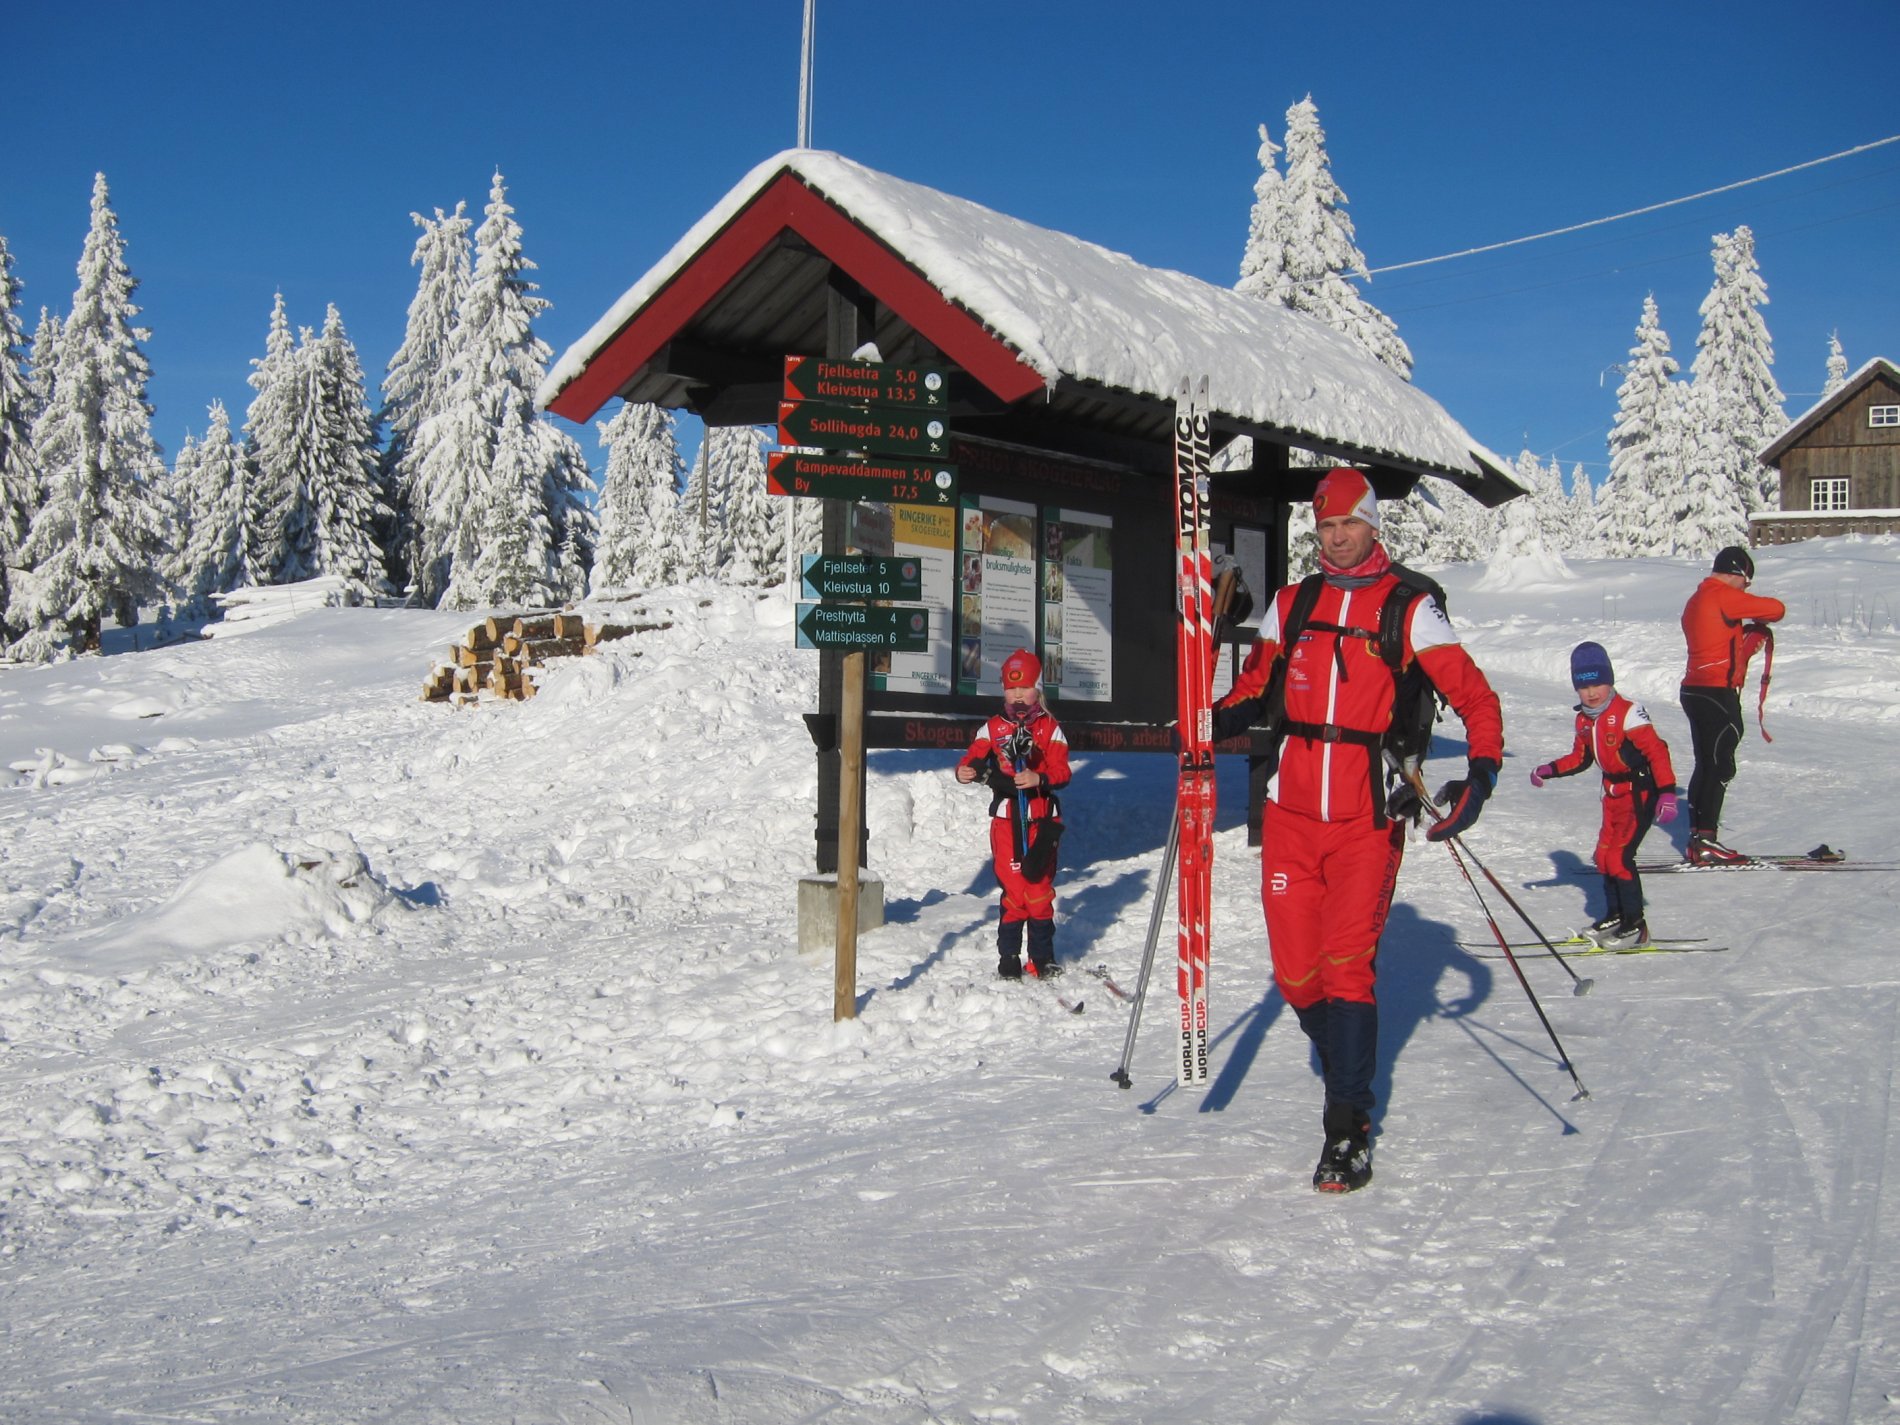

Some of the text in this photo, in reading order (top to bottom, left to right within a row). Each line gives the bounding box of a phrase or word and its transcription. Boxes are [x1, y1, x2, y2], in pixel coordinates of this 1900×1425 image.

[818, 363, 879, 381] Fjellsetra
[817, 382, 879, 398] Kleivstua
[810, 418, 881, 437] Sollihøgda
[795, 459, 906, 480] Kampevaddammen
[1193, 414, 1211, 529] TOMIC
[795, 478, 810, 493] By
[899, 509, 937, 526] RINGERIKE
[823, 560, 887, 575] Fjellseter 5
[985, 558, 1032, 576] bruksmuligheter
[823, 581, 873, 594] Kleivstua
[878, 582, 890, 594] 10
[815, 609, 897, 625] Presthytta 4
[815, 629, 884, 645] Mattisplassen
[889, 632, 897, 644] 6
[904, 720, 964, 748] Skogen
[1132, 727, 1171, 747] arbeid
